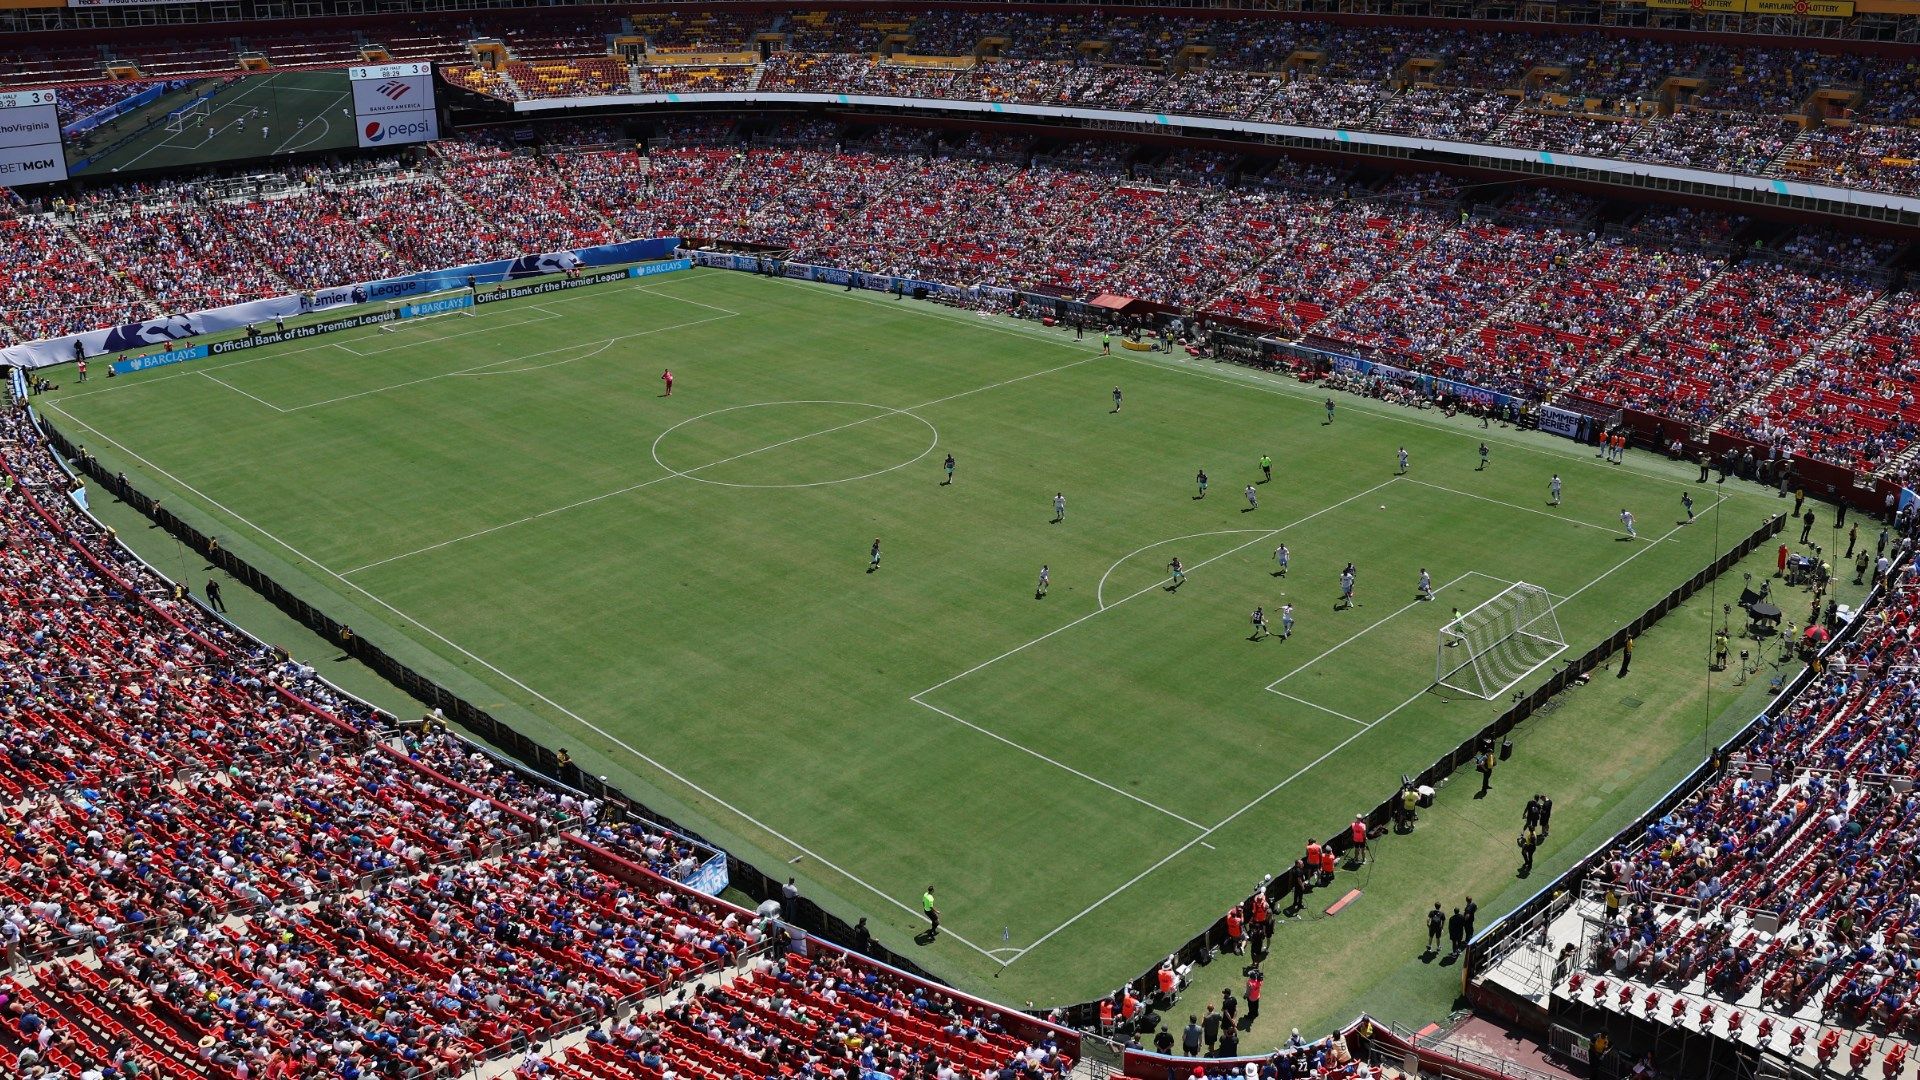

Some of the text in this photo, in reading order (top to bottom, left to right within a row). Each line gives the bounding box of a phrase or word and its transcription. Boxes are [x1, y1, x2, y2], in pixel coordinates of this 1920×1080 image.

[1759, 2, 1839, 12] MARYLAND LOTTERY
[361, 68, 367, 78] 3
[412, 64, 419, 74] 3
[32, 92, 40, 103] 3
[388, 119, 429, 138] pepsi
[645, 261, 682, 276] BARCLAYS
[370, 280, 416, 297] League
[477, 270, 626, 304] Official Bank of the Premier League
[422, 298, 464, 314] BARCLAYS
[213, 310, 396, 354] Official Bank of the Premier League
[143, 348, 197, 368] BARCLAYS
[1455, 385, 1494, 402] SEASON
[1540, 417, 1571, 432] SERIES
